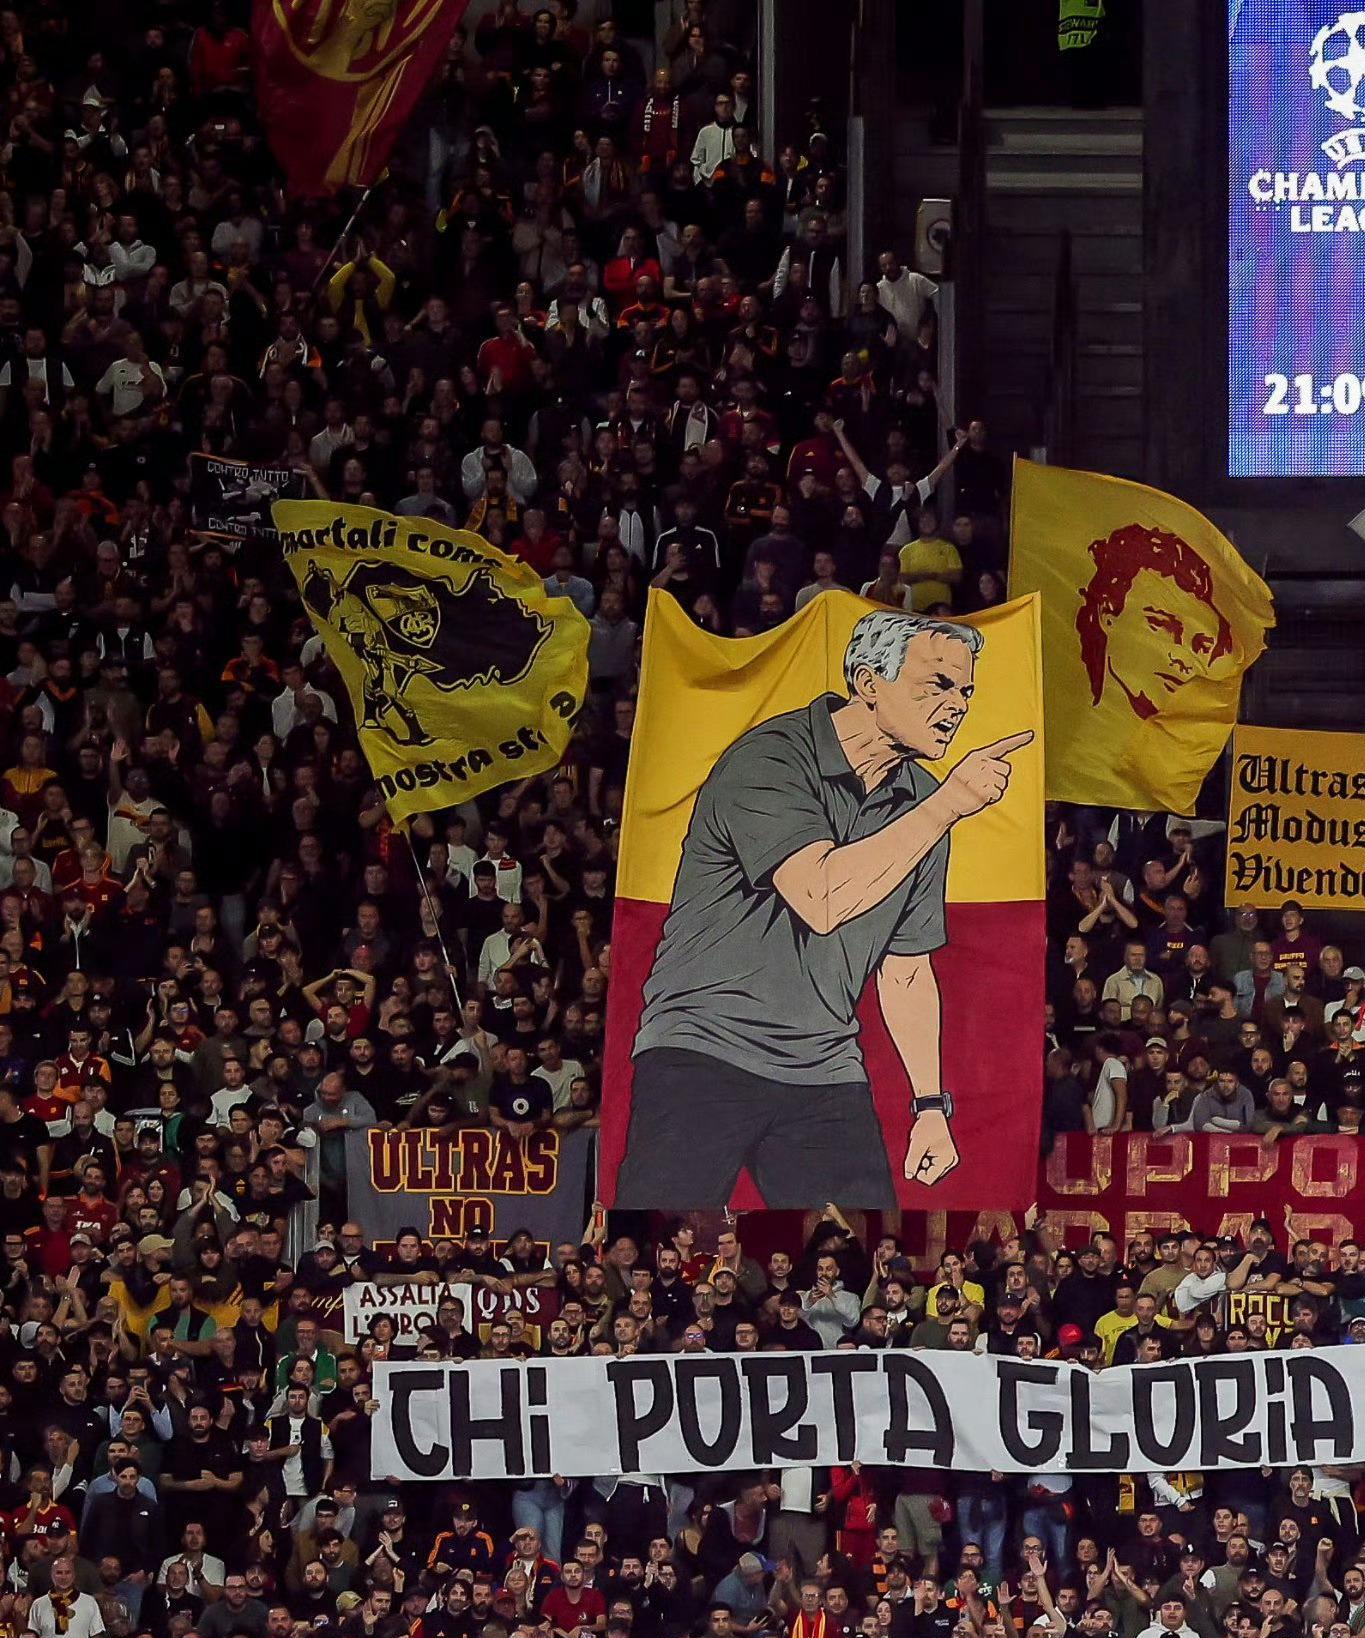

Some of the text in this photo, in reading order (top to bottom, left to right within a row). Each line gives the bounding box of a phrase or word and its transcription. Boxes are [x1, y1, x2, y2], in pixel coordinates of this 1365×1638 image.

[250, 526, 279, 538] TUTT
[367, 1128, 559, 1195] ULTRAS
[429, 1196, 495, 1238] NO
[606, 1354, 955, 1473] PORTA
